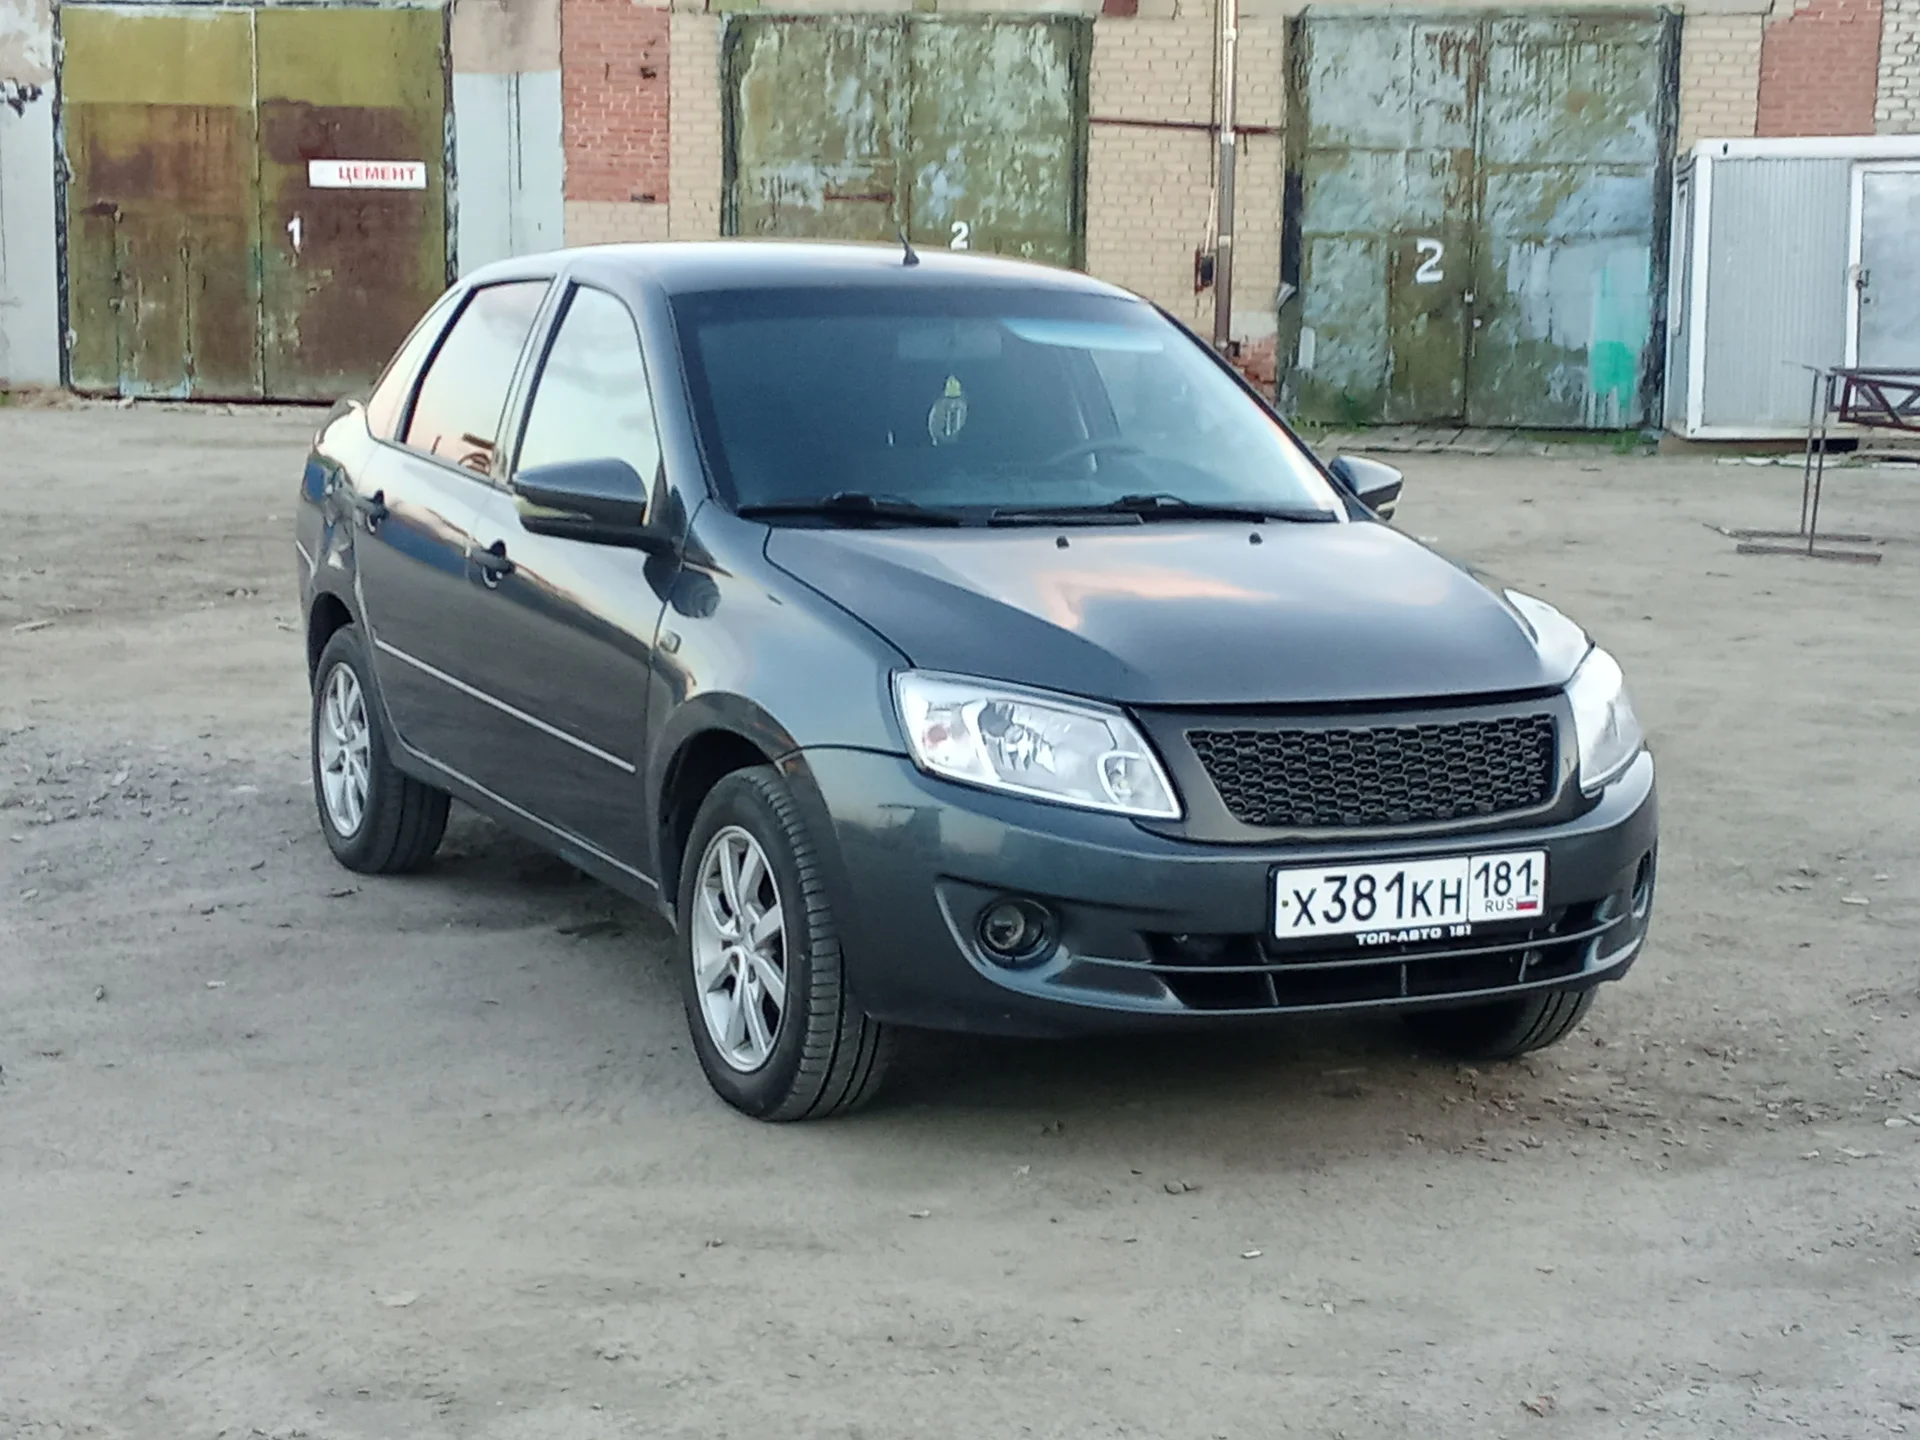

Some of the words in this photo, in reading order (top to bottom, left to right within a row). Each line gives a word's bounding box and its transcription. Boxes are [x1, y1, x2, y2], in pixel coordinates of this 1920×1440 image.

[338, 166, 416, 183] ЦЕМЕНТ
[287, 213, 301, 251] 1
[950, 220, 969, 250] 2
[1416, 238, 1444, 284] 2
[1292, 871, 1463, 928] Х381КН
[1474, 858, 1533, 899] 181
[1484, 898, 1515, 913] RUS
[1356, 926, 1442, 946] ТОП-АВТО
[1449, 923, 1472, 938] 181
